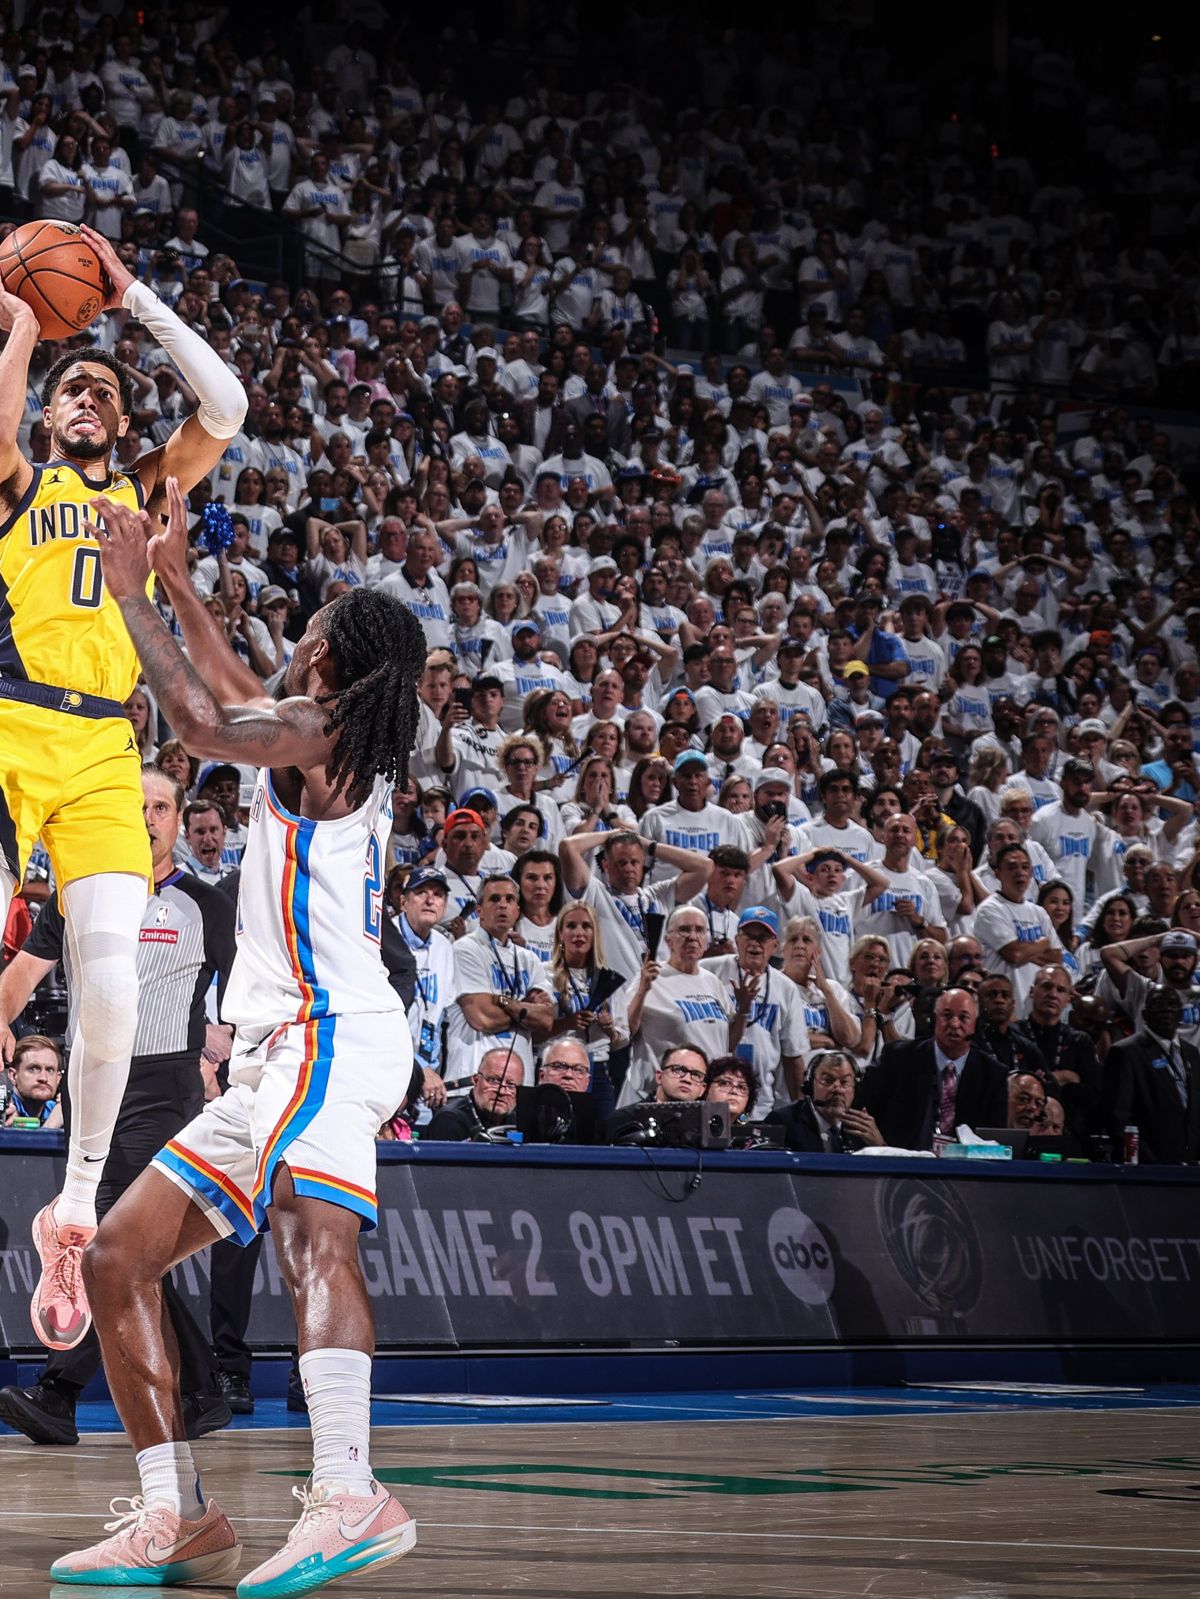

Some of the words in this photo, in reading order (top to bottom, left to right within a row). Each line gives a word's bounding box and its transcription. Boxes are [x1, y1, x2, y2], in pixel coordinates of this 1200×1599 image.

[29, 501, 111, 546] INDIA
[70, 545, 103, 608] 0
[665, 830, 719, 851] THUNDER
[140, 930, 178, 942] Emirates
[359, 1209, 512, 1297] GAME
[512, 1210, 558, 1297] 2
[568, 1210, 693, 1298] 8PM
[687, 1216, 754, 1297] ET
[775, 1237, 831, 1271] abc
